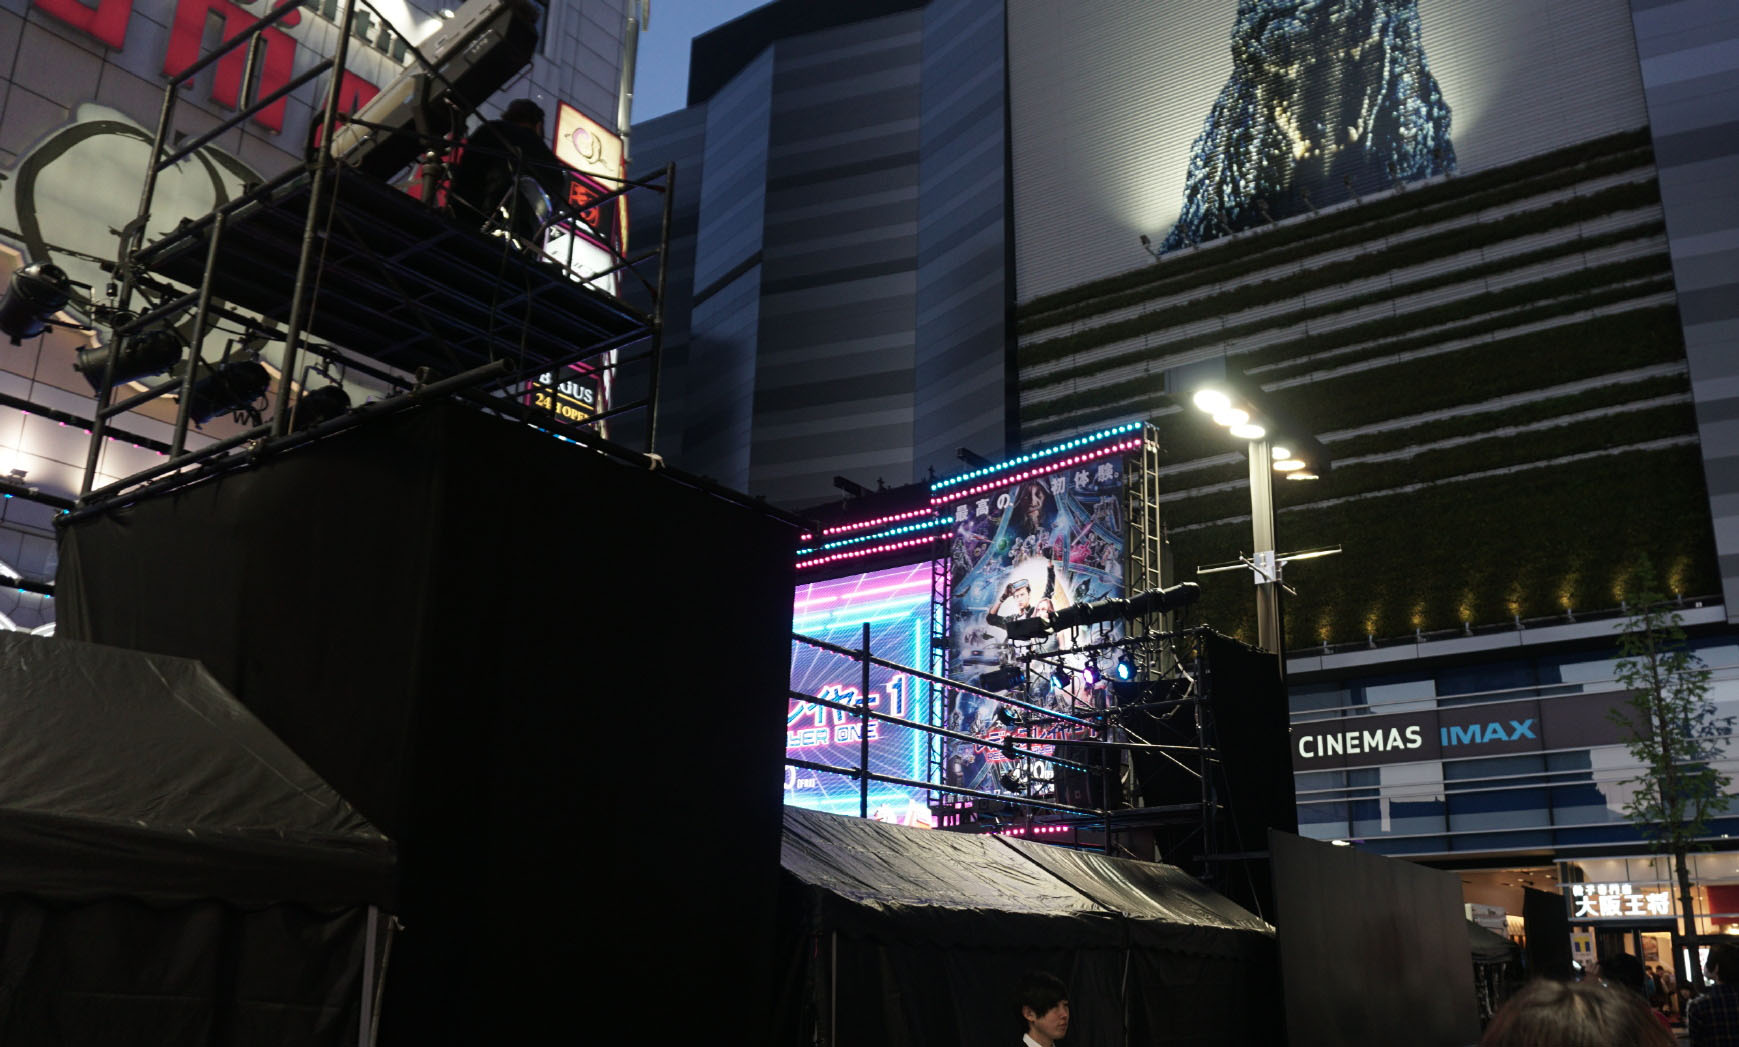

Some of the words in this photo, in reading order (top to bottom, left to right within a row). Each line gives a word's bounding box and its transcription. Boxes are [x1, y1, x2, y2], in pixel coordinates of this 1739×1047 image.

[539, 372, 593, 404] BGUS
[787, 728, 829, 748] YER
[835, 721, 879, 744] ONE
[1298, 725, 1423, 758] CINEMAS
[1440, 719, 1536, 746] IMAX
[1575, 892, 1670, 917] 大阪王将
